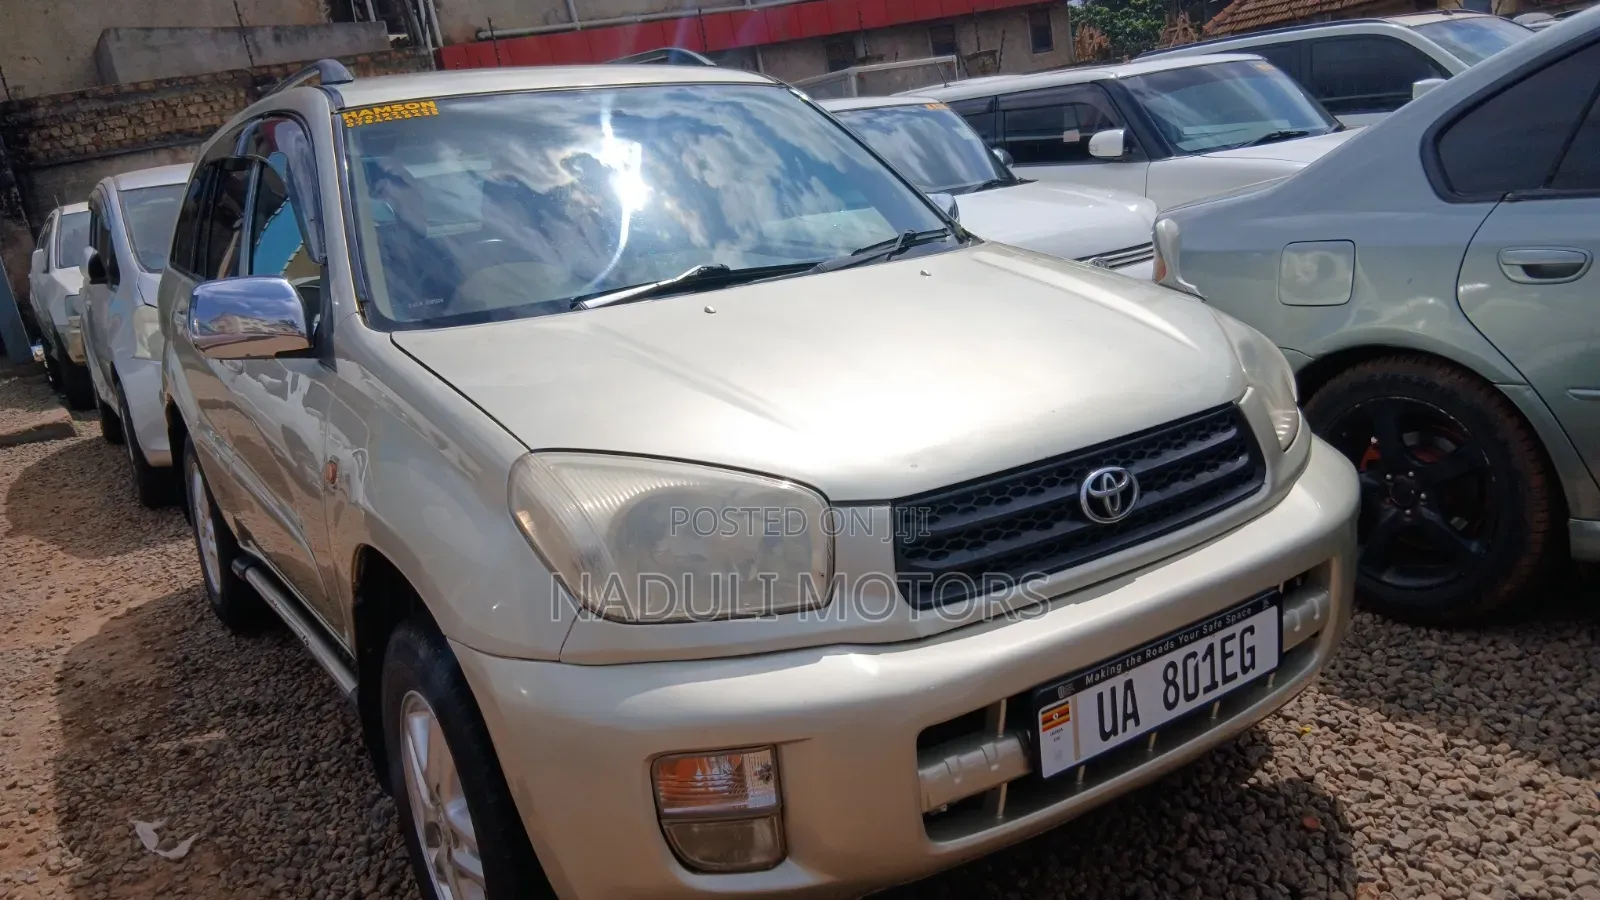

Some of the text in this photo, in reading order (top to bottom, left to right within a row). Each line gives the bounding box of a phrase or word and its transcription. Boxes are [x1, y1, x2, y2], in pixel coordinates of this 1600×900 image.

[342, 101, 436, 119] HAMSON
[1085, 608, 1252, 685] Making the Roads Your Safe Space
[1097, 624, 1256, 742] UA 801EG
